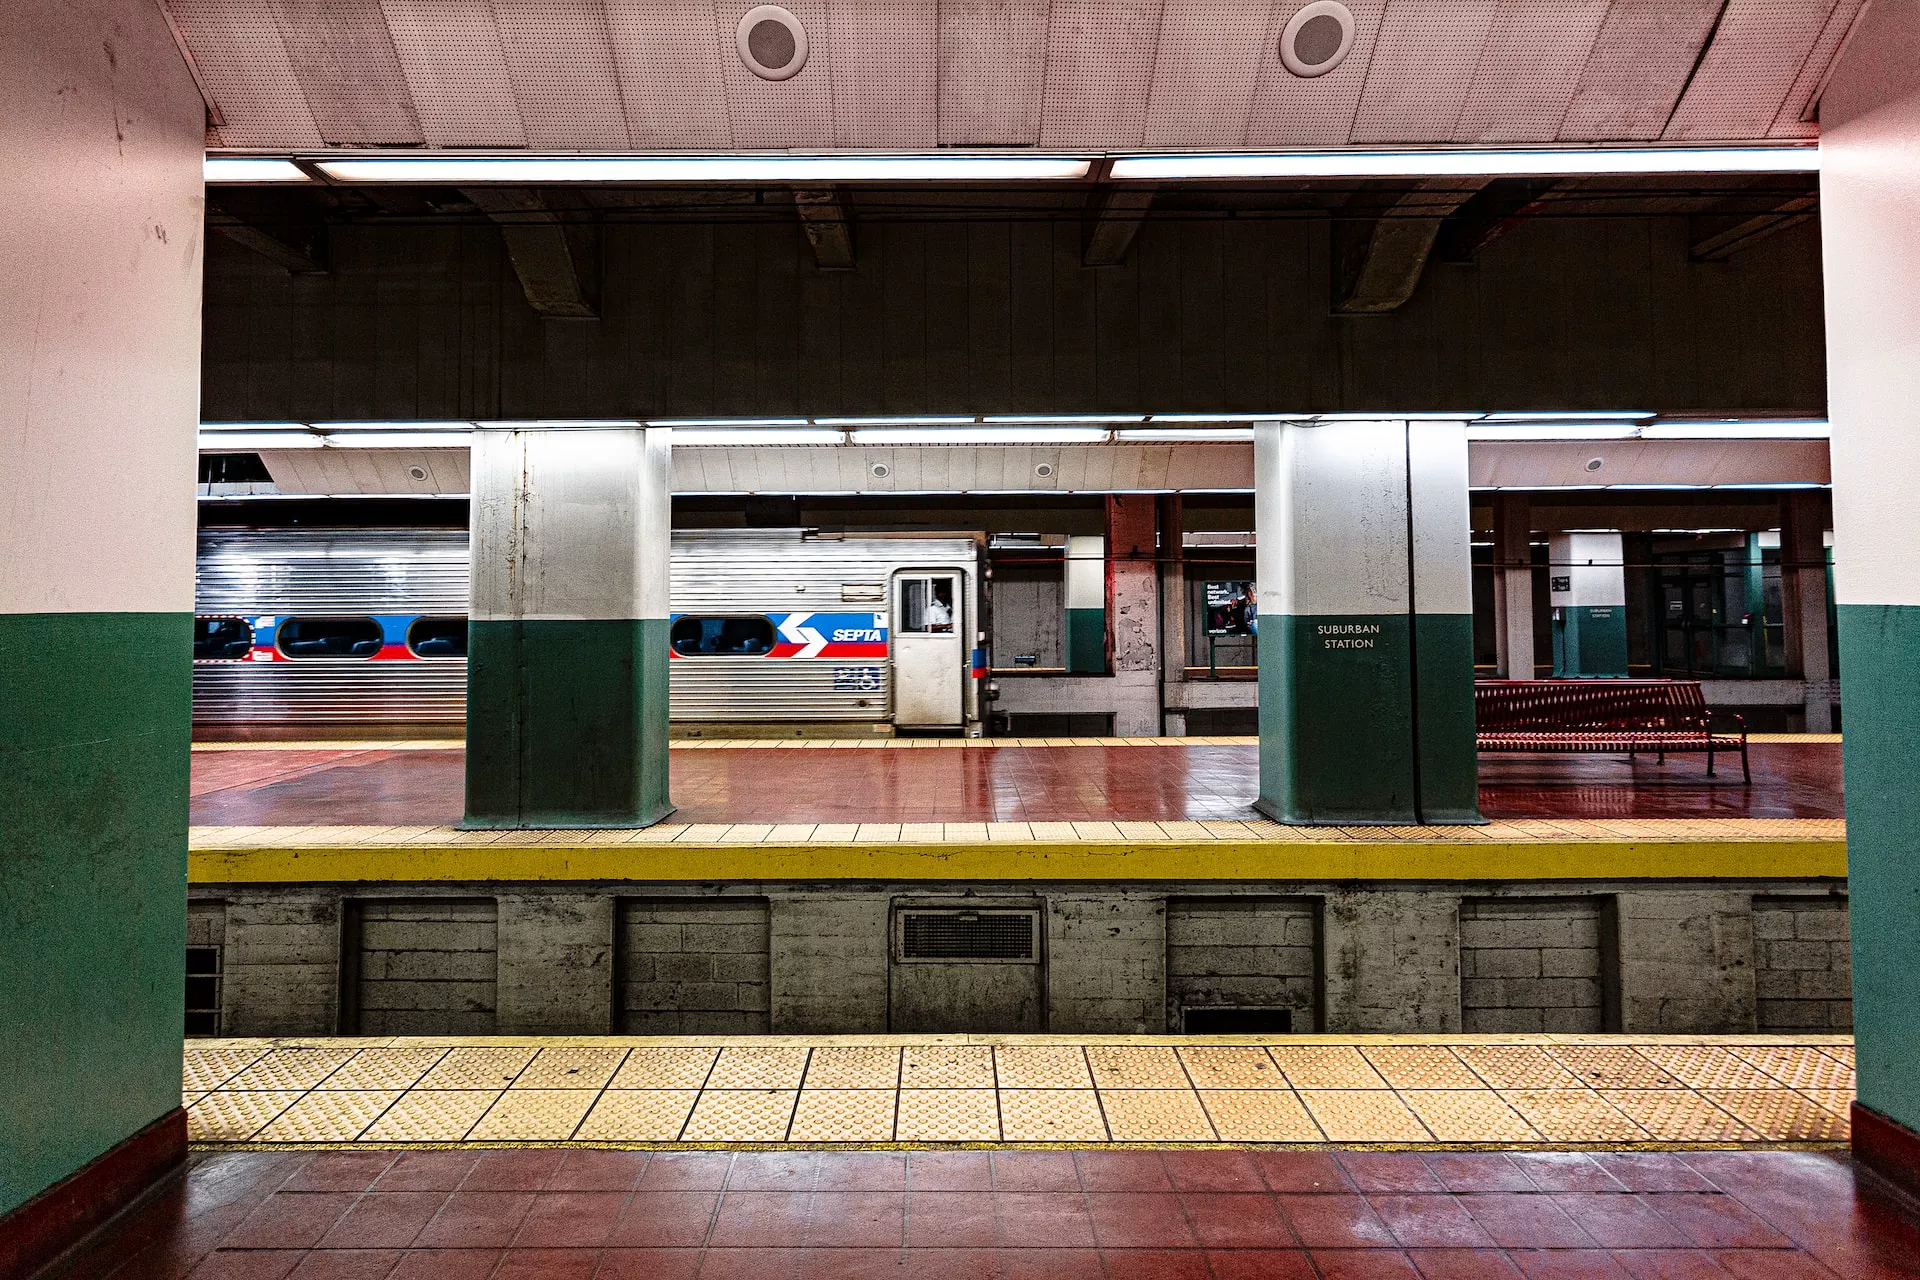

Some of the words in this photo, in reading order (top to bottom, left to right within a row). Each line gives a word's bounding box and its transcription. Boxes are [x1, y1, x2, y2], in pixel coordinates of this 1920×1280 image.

[832, 628, 882, 642] SEPTA
[1317, 624, 1380, 635] SUBURBAN
[1324, 639, 1374, 649] STATION
